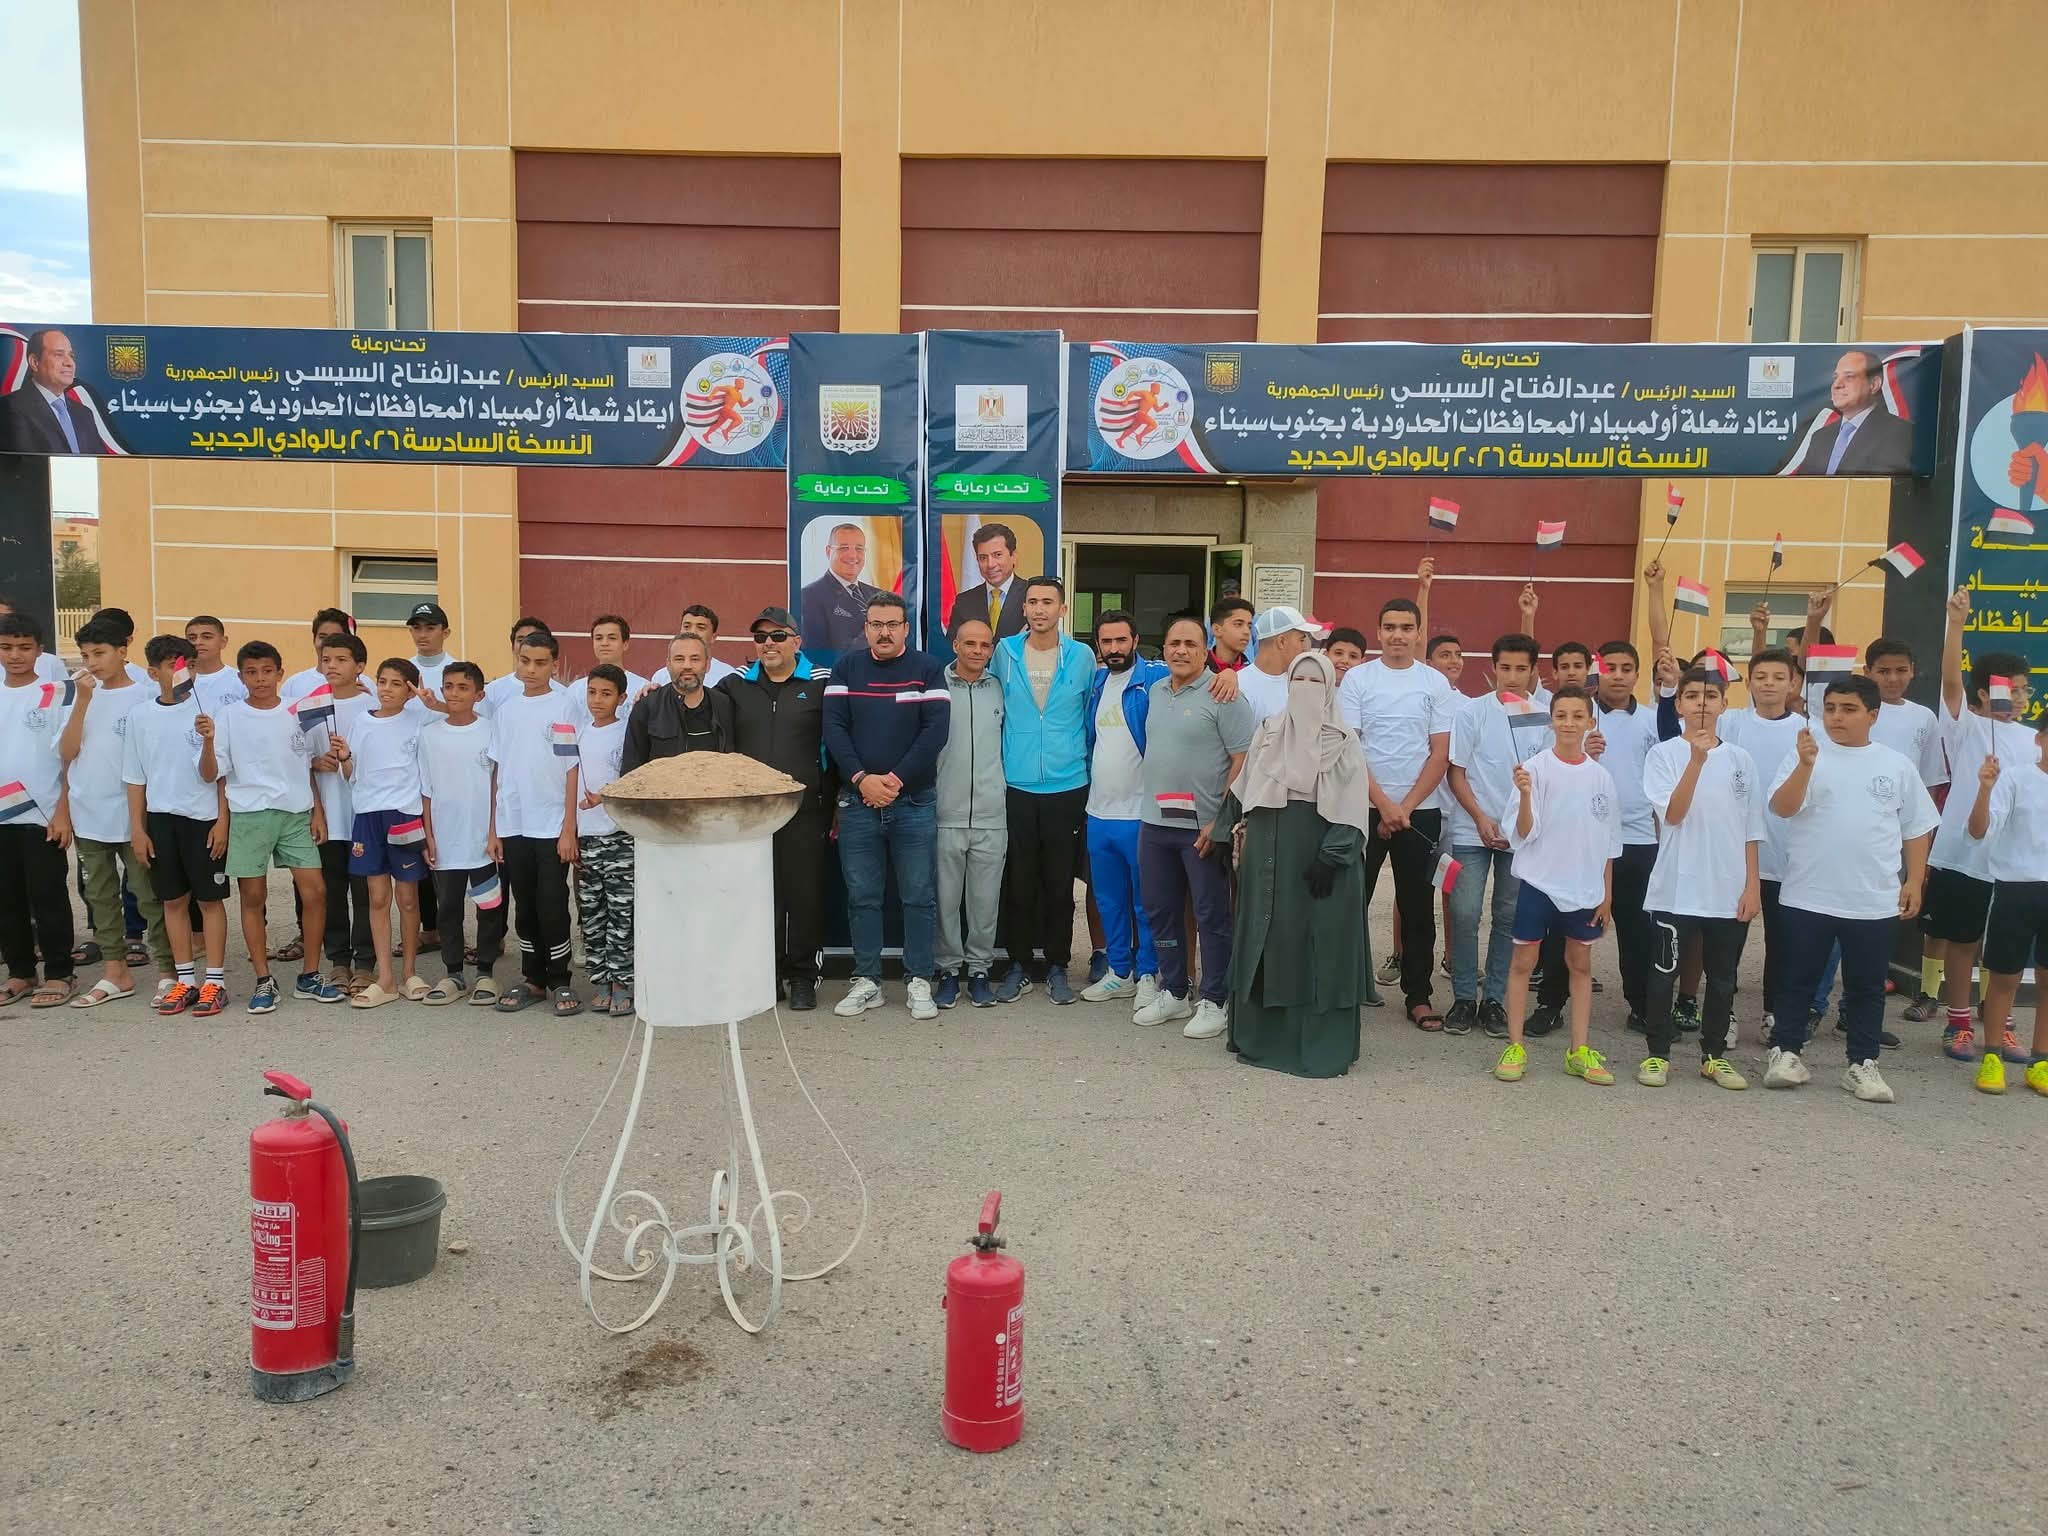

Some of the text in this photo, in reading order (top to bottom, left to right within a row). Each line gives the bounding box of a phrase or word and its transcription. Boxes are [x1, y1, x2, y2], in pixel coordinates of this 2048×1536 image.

[351, 334, 426, 354] تحت رعاية
[1461, 349, 1540, 369] تحت رعاية
[165, 363, 236, 384] الجمهورية
[239, 366, 280, 383] رئيس
[284, 362, 384, 391] السيسي
[518, 373, 568, 389] الرئيس
[571, 375, 614, 390] السيد
[1267, 380, 1340, 400] الجمهورية
[1344, 383, 1385, 401] رئيس
[1390, 377, 1494, 408] السيسي
[1634, 384, 1687, 401] الرئيس
[1690, 385, 1736, 401] السيد
[107, 387, 674, 430] ايقاد شعلة أولمبياد المحافظات الحدودية بجنوب سيناء
[1681, 407, 1740, 434] شعلة
[1204, 406, 1269, 438] سيناء
[1270, 408, 1347, 440] بجنوب
[1351, 408, 1457, 440] الحدودية
[1460, 408, 1585, 435] المحافظات
[1589, 405, 1677, 442] أولمبياد
[1743, 409, 1798, 441] ايقاد
[190, 427, 593, 458] النسخة السادسة ٢٠٢٦ بالوادي الجديد
[1288, 443, 1708, 475] النسخة السادسة ٢٠٢٦ بالوادي الجديد
[814, 481, 889, 498] تحت رعاية
[954, 480, 1030, 497] تحت رعاية
